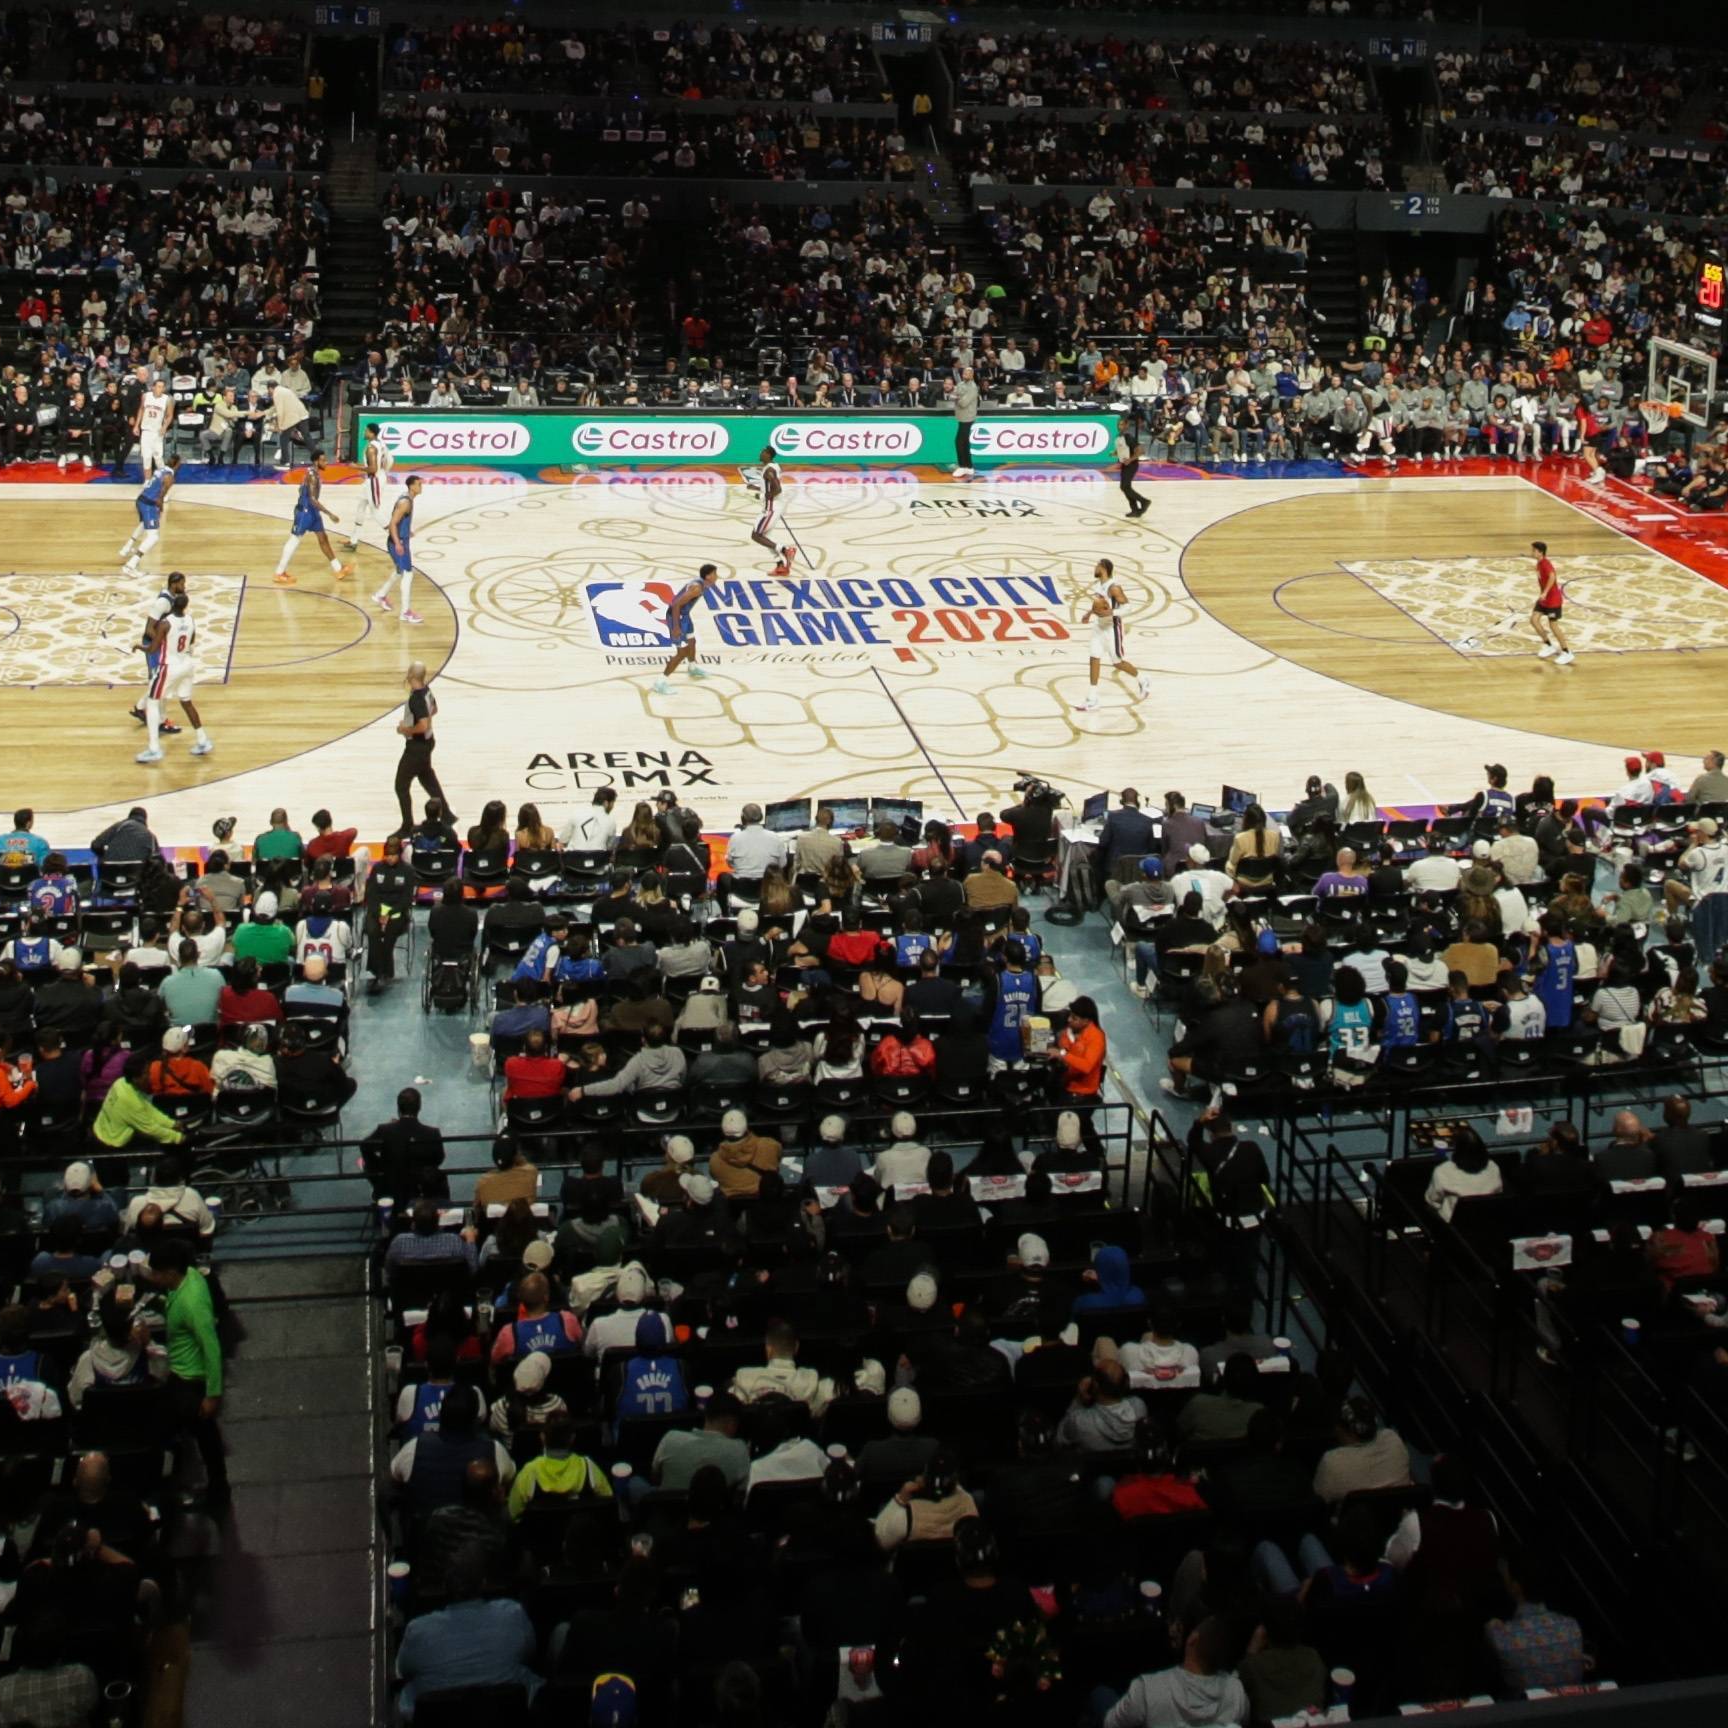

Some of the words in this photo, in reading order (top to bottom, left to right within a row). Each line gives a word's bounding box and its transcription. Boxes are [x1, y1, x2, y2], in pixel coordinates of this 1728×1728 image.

[1407, 196, 1423, 215] 2
[1699, 277, 1721, 307] 20
[407, 428, 517, 451] Castrol
[609, 429, 715, 450] Castrol
[806, 429, 910, 451] Castrol
[996, 429, 1097, 450] Castrol
[909, 499, 1037, 509] ARENA
[912, 509, 1045, 519] CDMX
[703, 578, 926, 611] MEXICO
[929, 575, 1065, 607] CITY
[713, 610, 891, 647] GAME
[892, 607, 1070, 643] 2025
[177, 636, 187, 653] 8
[609, 632, 660, 646] NBA
[701, 654, 721, 665] by
[938, 649, 1069, 658] ULTRA
[526, 750, 713, 770] ARENA
[525, 768, 722, 790] CDMX
[1714, 867, 1724, 883] 4
[1556, 969, 1567, 989] 3
[1338, 1026, 1370, 1047] 33
[635, 1392, 672, 1413] 77
